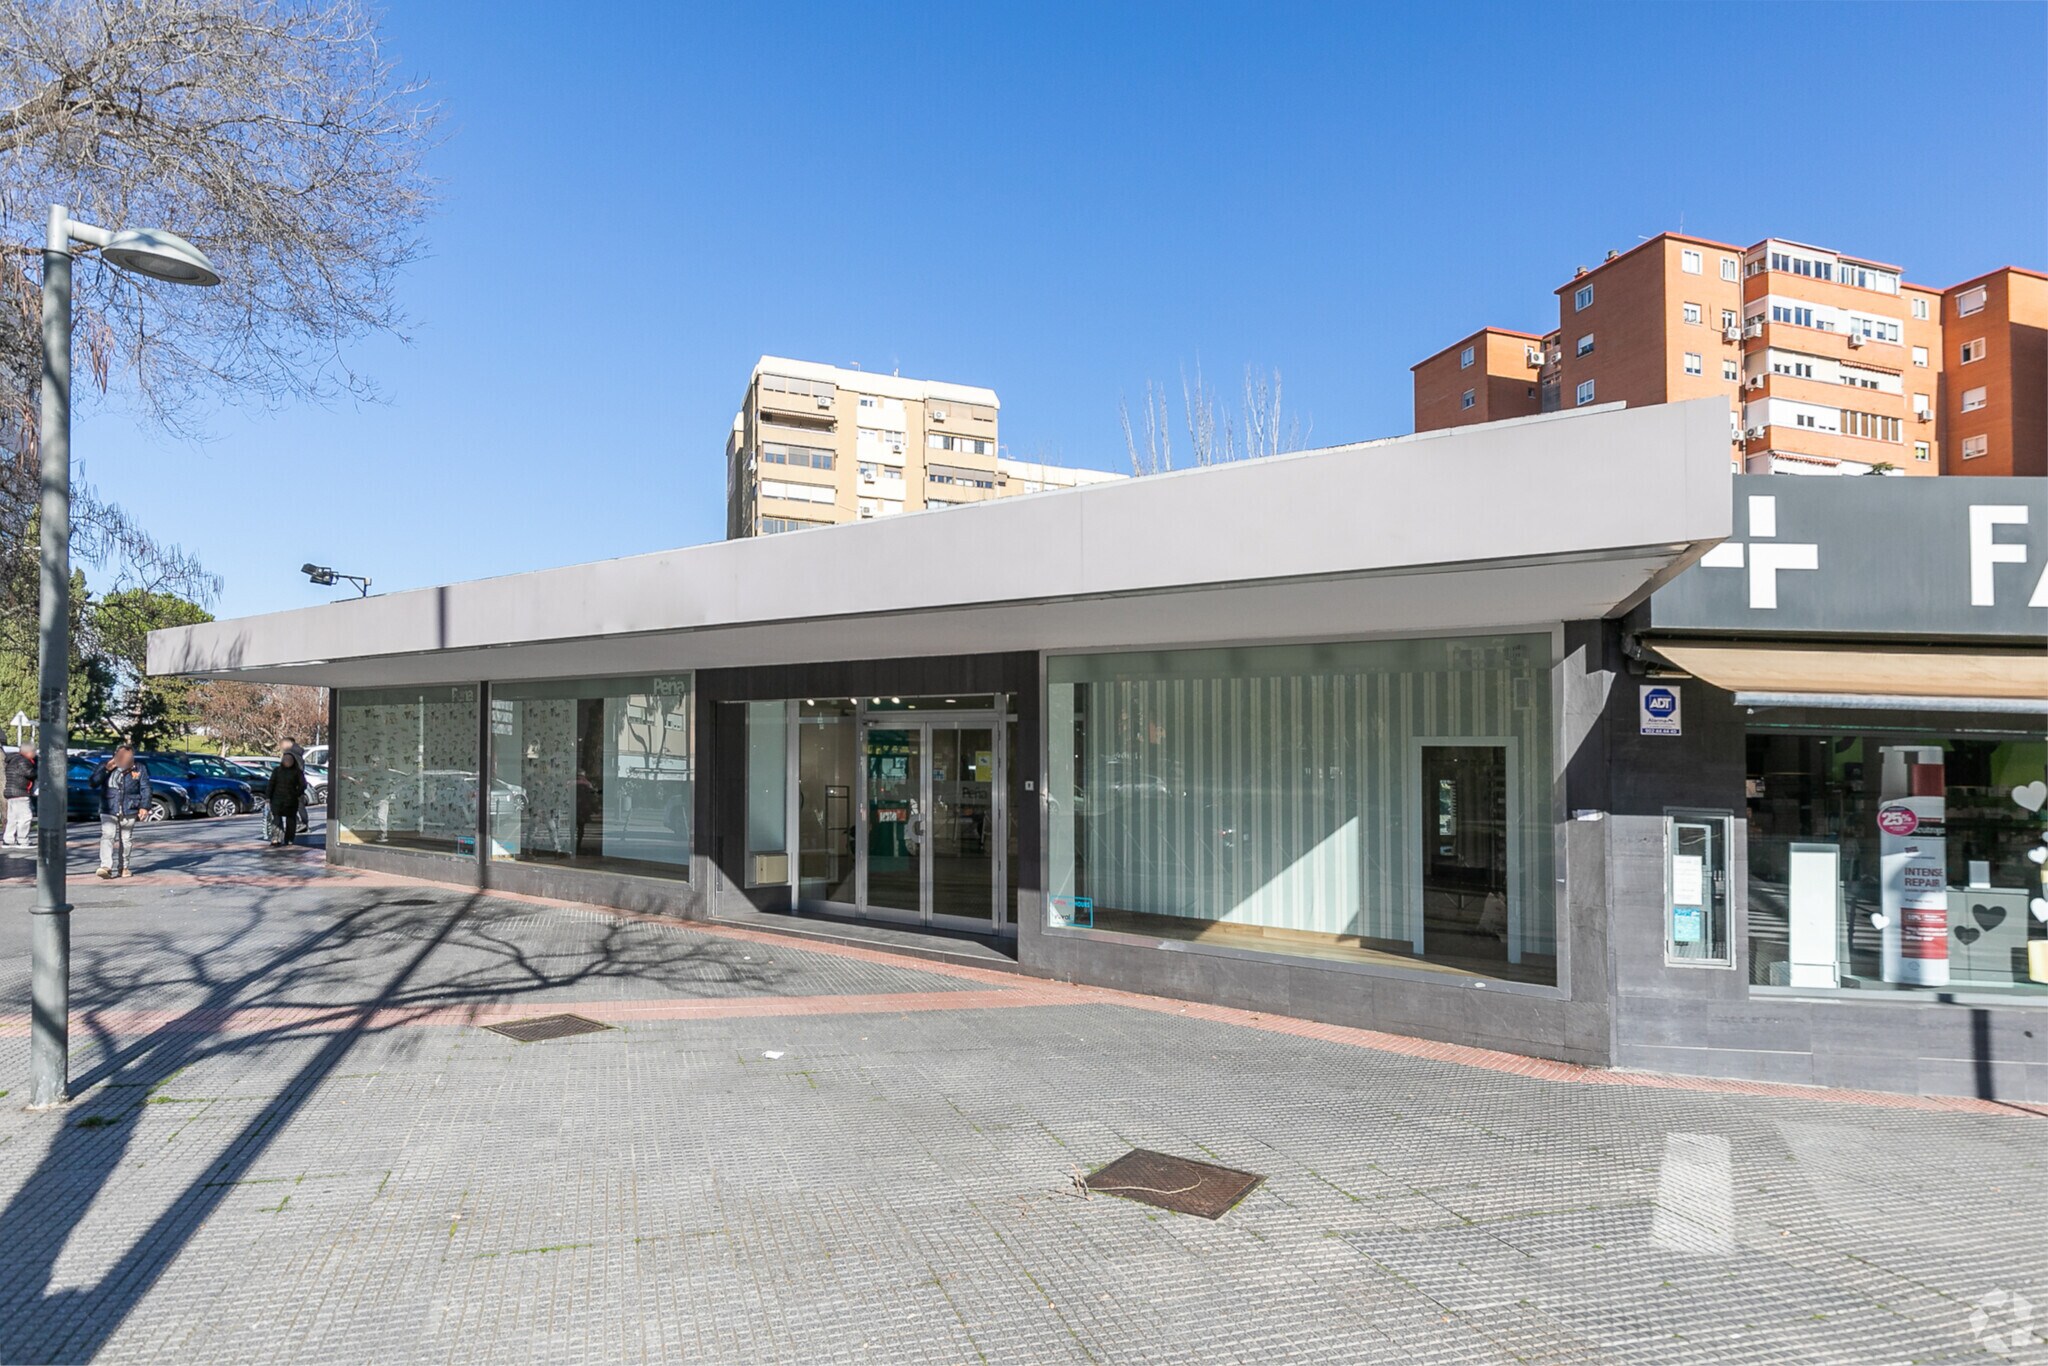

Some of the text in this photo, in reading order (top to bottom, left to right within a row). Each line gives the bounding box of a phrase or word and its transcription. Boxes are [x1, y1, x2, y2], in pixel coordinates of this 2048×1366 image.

[1969, 505, 2048, 607] F
[653, 676, 685, 695] Peña
[1650, 698, 1671, 709] ADT
[1881, 812, 1913, 826] 25%
[1904, 867, 1944, 877] INTENSE
[1904, 877, 1941, 887] REPAIR
